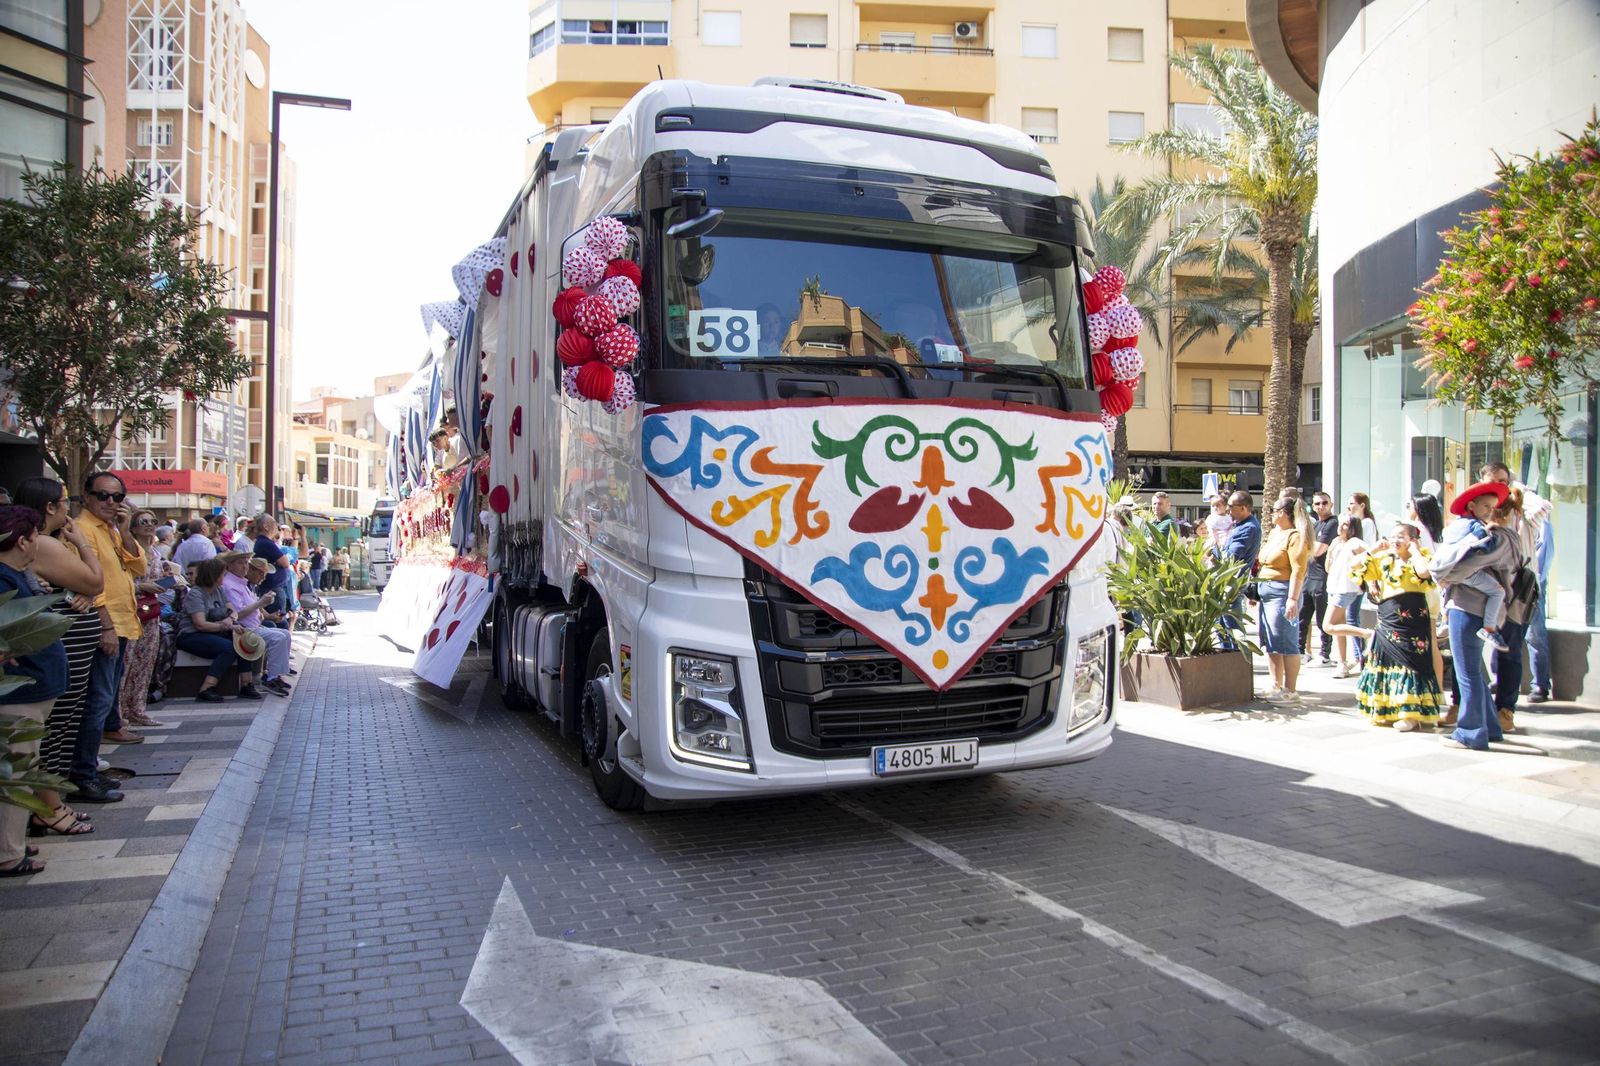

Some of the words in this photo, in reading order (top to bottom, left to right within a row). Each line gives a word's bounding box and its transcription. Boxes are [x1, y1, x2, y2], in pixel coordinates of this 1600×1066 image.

[696, 315, 751, 353] 58
[131, 478, 173, 486] zinkvalue
[889, 747, 934, 768] 4805
[940, 743, 973, 764] MLJ
